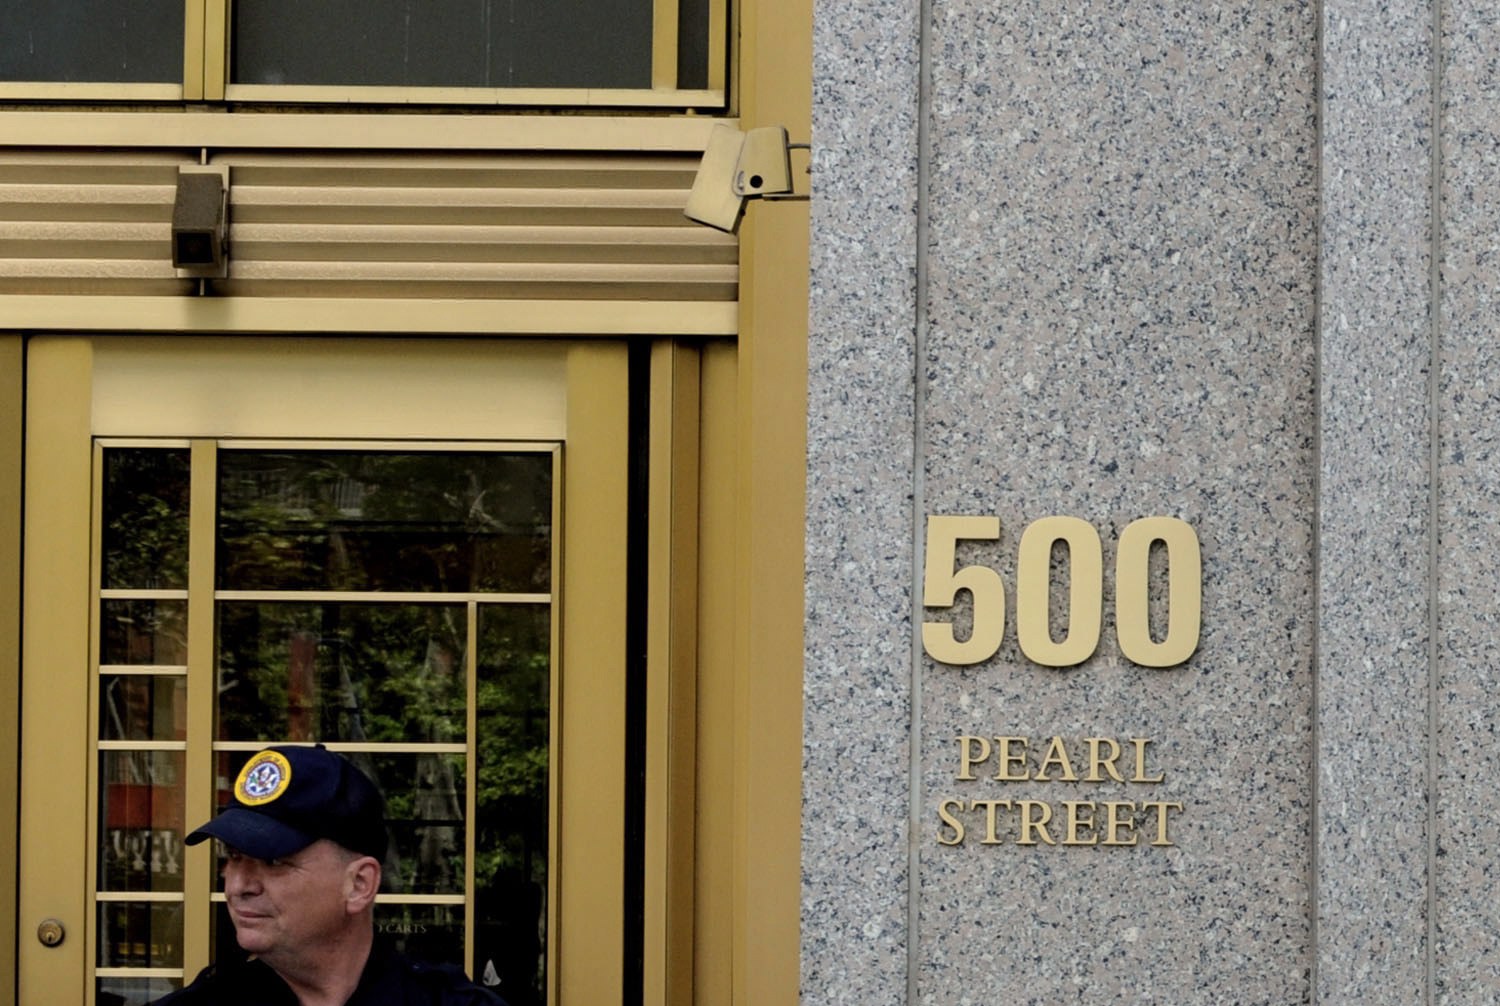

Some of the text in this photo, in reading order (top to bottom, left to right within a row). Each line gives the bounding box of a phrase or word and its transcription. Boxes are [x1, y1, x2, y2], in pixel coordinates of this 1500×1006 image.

[921, 515, 1202, 667] 500
[955, 735, 1165, 783] PEARL
[936, 799, 1183, 845] STREET
